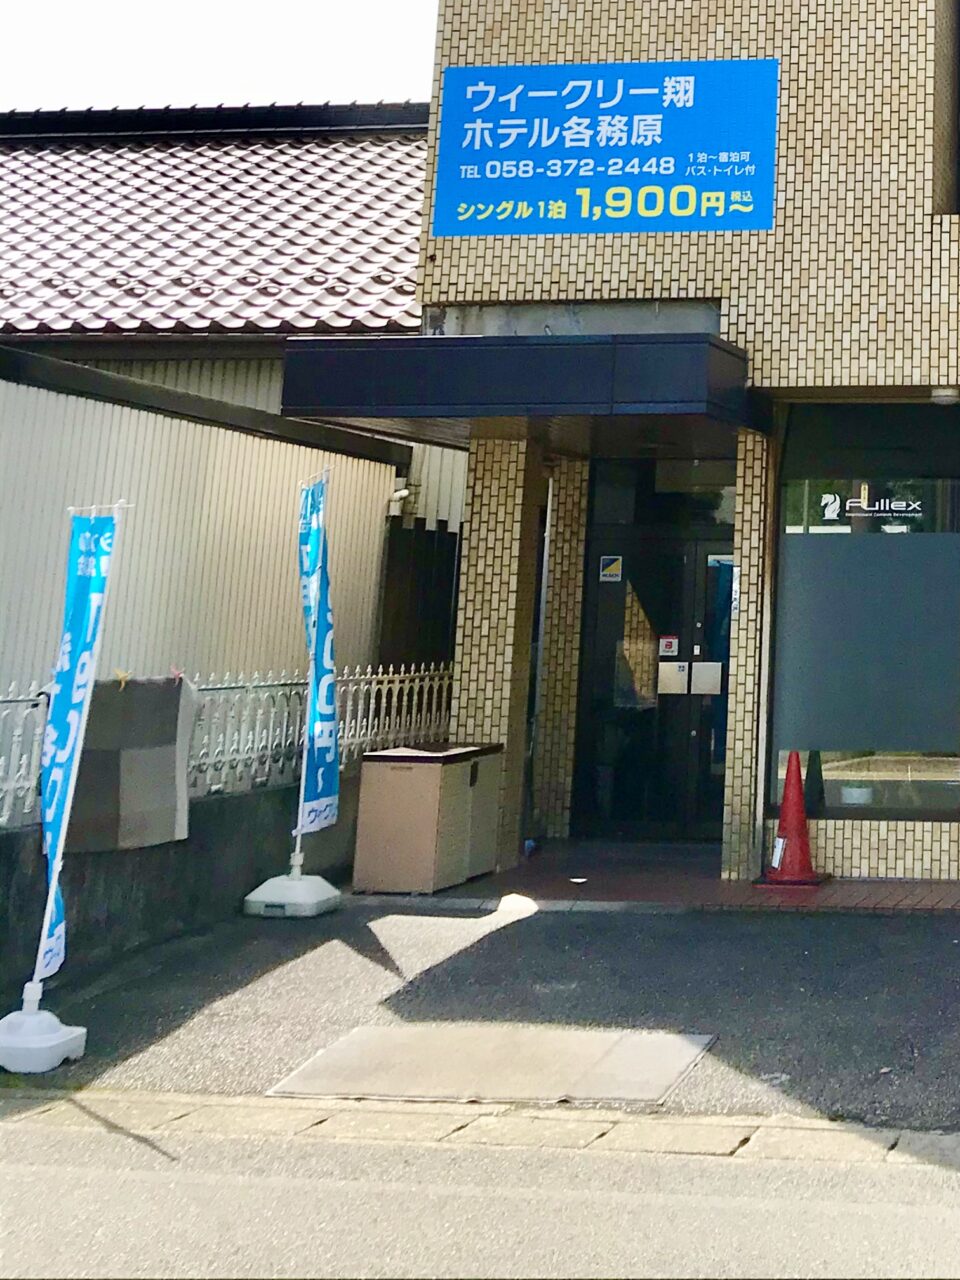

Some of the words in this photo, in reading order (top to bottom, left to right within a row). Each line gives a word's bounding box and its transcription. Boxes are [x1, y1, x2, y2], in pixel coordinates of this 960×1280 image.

[466, 75, 695, 112] ウィークリー翔
[462, 114, 663, 150] ホテル各務原
[459, 165, 481, 179] TEL
[485, 156, 675, 179] 058-372-2448
[845, 498, 922, 511] Fullex
